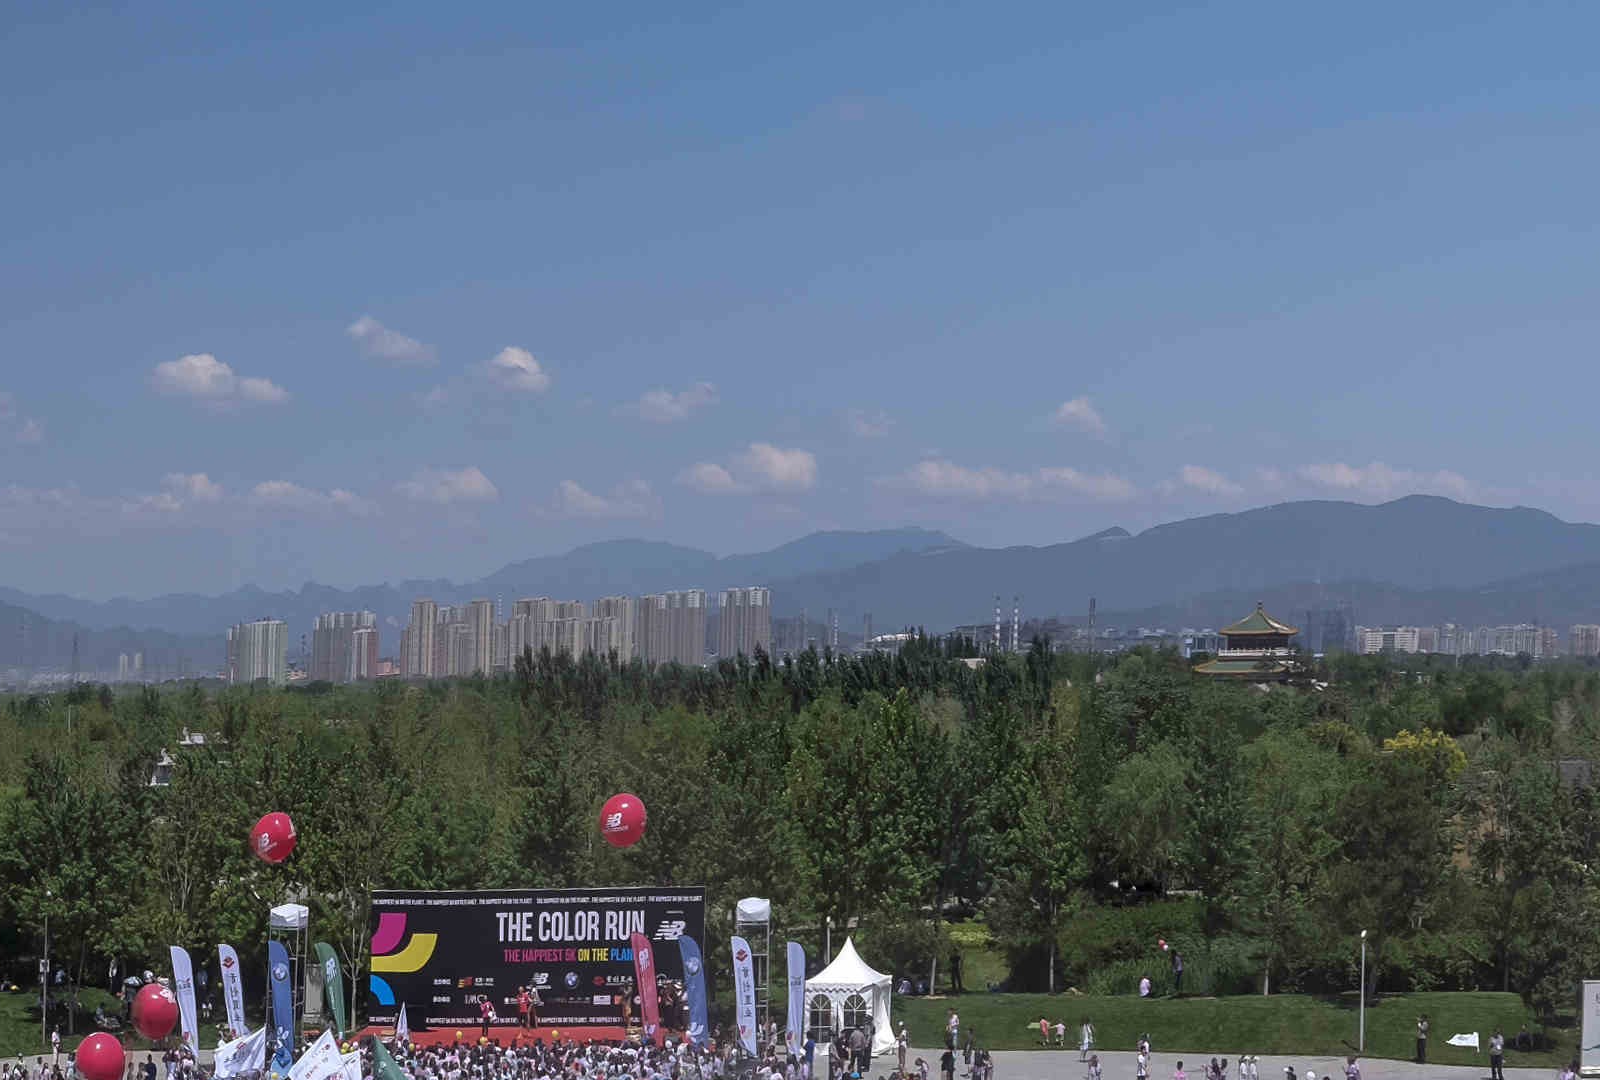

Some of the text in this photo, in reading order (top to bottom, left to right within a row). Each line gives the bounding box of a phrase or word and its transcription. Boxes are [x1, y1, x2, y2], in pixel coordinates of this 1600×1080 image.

[496, 910, 645, 942] THE COLOR RUN
[504, 949, 520, 962] THE
[522, 948, 563, 962] HAPPIEST
[578, 948, 590, 962] ON
[591, 948, 609, 962] THE
[610, 947, 634, 961] PLAN
